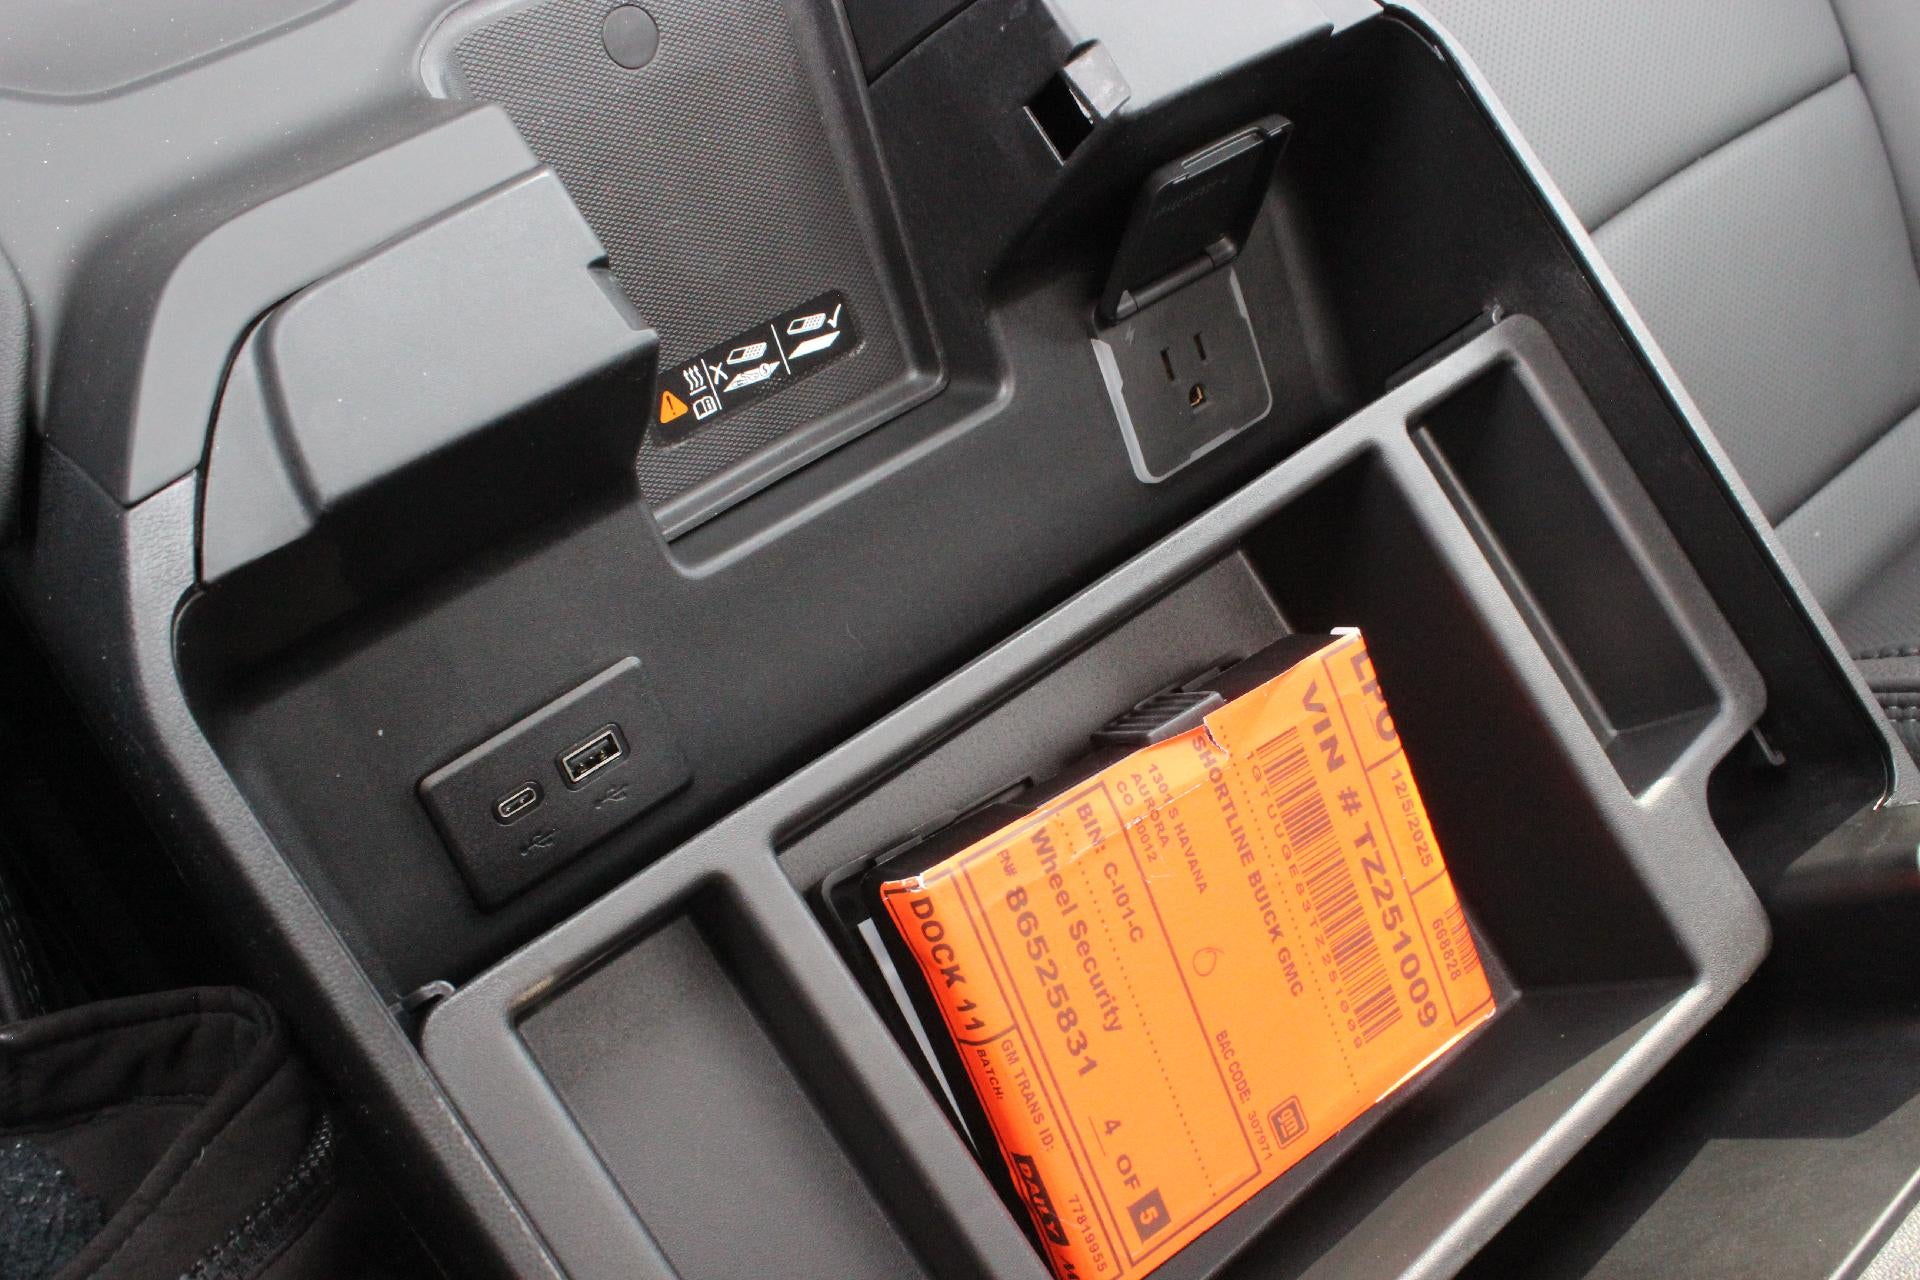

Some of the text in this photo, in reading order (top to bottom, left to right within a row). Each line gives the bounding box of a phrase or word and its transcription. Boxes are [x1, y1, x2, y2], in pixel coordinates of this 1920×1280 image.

[1076, 803, 1106, 854] BIN:
[1117, 781, 1134, 806] CO
[1131, 774, 1169, 847] AURORA
[1149, 764, 1207, 894] 1301 S HAVANA
[1302, 680, 1438, 1027] VIN # TZ251009
[1391, 769, 1434, 867] 12/5/2025
[1029, 826, 1123, 1032] Wheel Security
[1189, 733, 1303, 997] SHORTLINE BUICK GMC
[910, 892, 985, 1030] DOCK 11
[1432, 918, 1461, 981] 668828
[977, 1049, 1003, 1099] BATCH:
[1005, 885, 1097, 1076] 86525831
[1105, 1120, 1121, 1135] 4
[1117, 1154, 1140, 1189] OF
[1216, 1030, 1273, 1160] BAC CODE: 307971
[1002, 1039, 1019, 1065] GM
[1014, 1068, 1045, 1125] TRANS
[1039, 1128, 1054, 1151] ID:
[1069, 1194, 1107, 1272] 77819955
